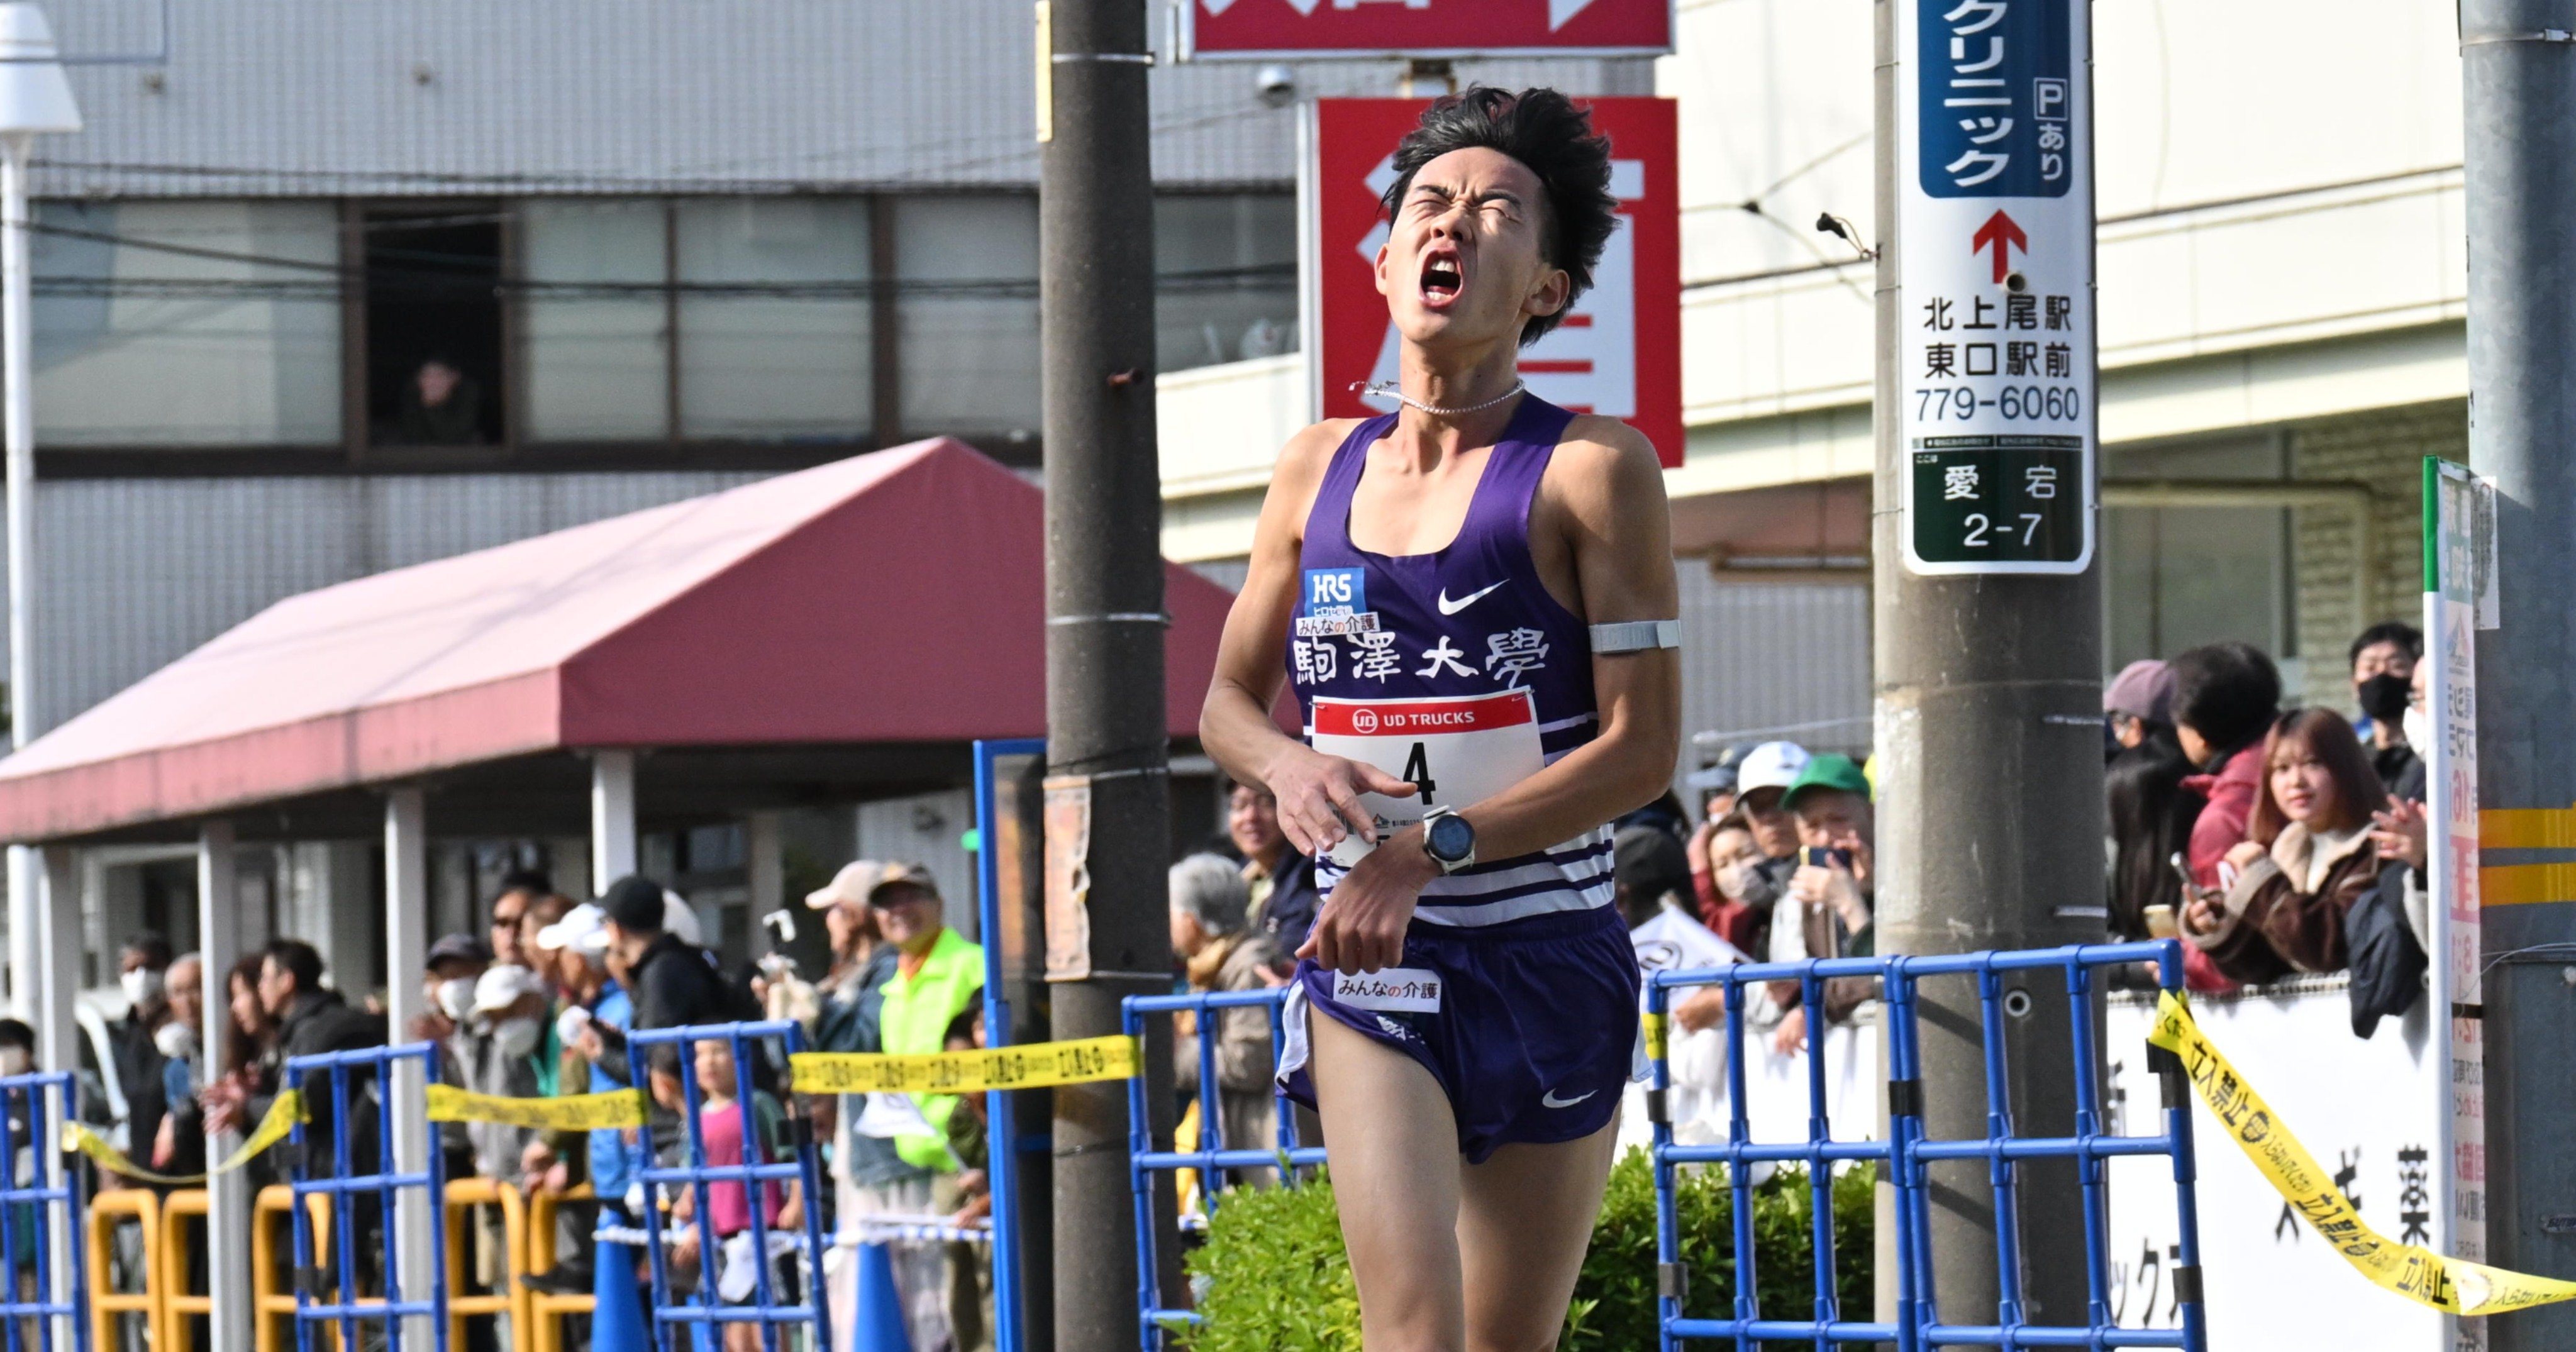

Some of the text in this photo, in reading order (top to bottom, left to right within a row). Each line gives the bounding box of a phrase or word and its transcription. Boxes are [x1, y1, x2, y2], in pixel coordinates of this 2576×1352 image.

[1943, 0, 2014, 187] クリニック
[1923, 295, 2072, 331] 北上尾駅
[1924, 341, 2072, 378] 東口駅前
[1916, 385, 2079, 421] 779-6060
[1963, 513, 2043, 546] 2-7
[1313, 573, 1352, 604] HRS
[1299, 614, 1376, 635] みんなの介護
[1293, 626, 1550, 689] 駒澤大學
[1384, 711, 1475, 727] UD TRUCKS
[1402, 742, 1436, 805] 4
[1338, 979, 1438, 1000] みんなの介護
[2190, 1040, 2249, 1127] 立入禁止
[2293, 1192, 2368, 1244] 立入禁止
